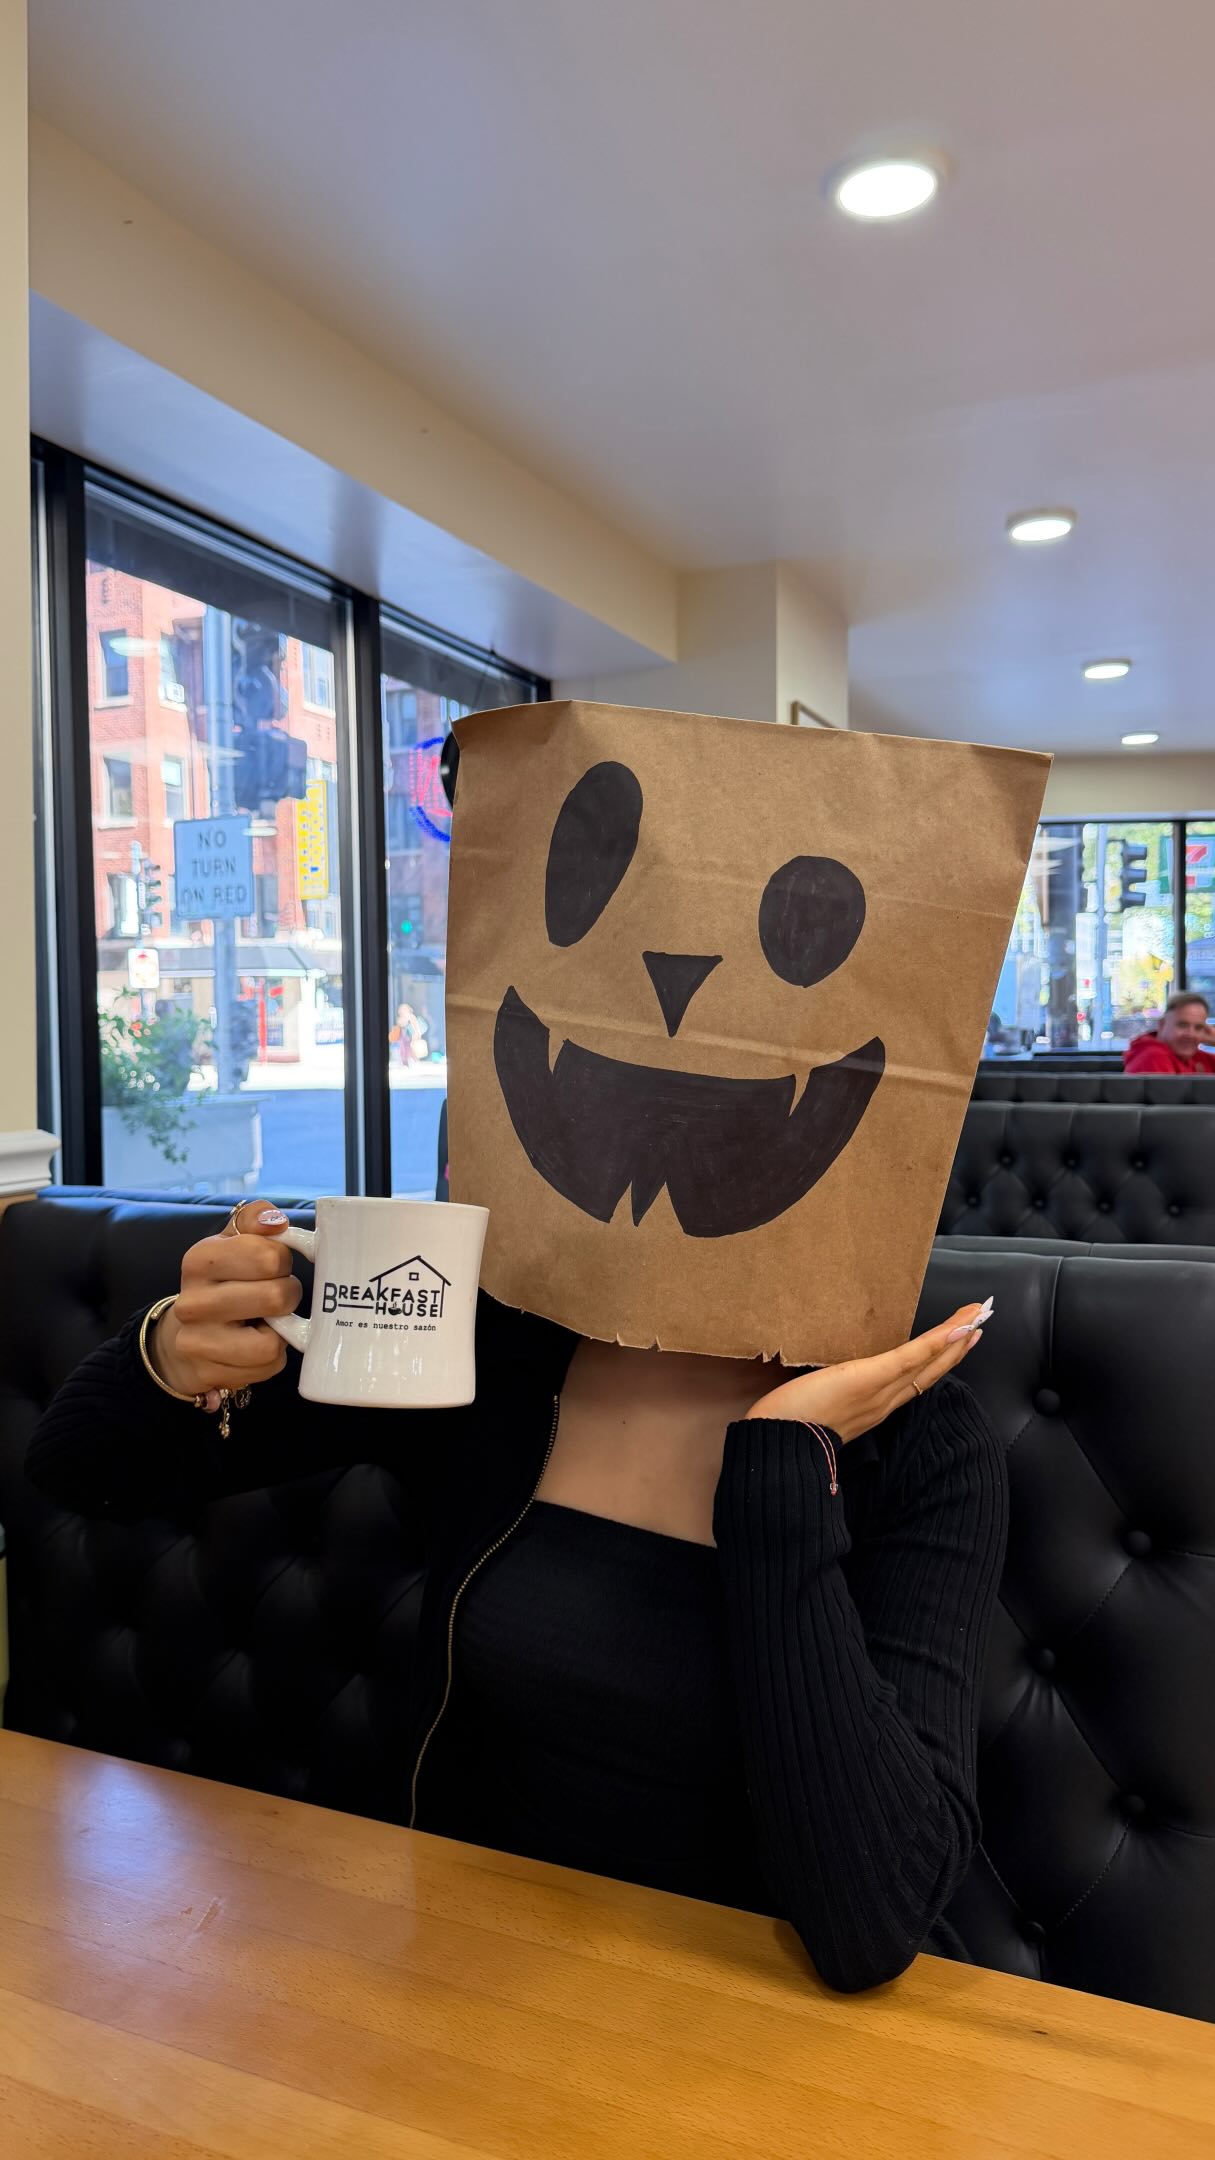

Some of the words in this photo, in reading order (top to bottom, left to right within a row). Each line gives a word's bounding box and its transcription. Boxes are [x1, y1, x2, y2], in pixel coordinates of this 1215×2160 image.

[197, 829, 227, 851] NO
[191, 857, 236, 880] TURN
[181, 886, 205, 906] ON
[213, 884, 248, 905] RED
[322, 1282, 440, 1313] BREAKFAST
[335, 1319, 354, 1328] Amor
[373, 1322, 409, 1331] nuestro
[413, 1324, 437, 1332] sazón
